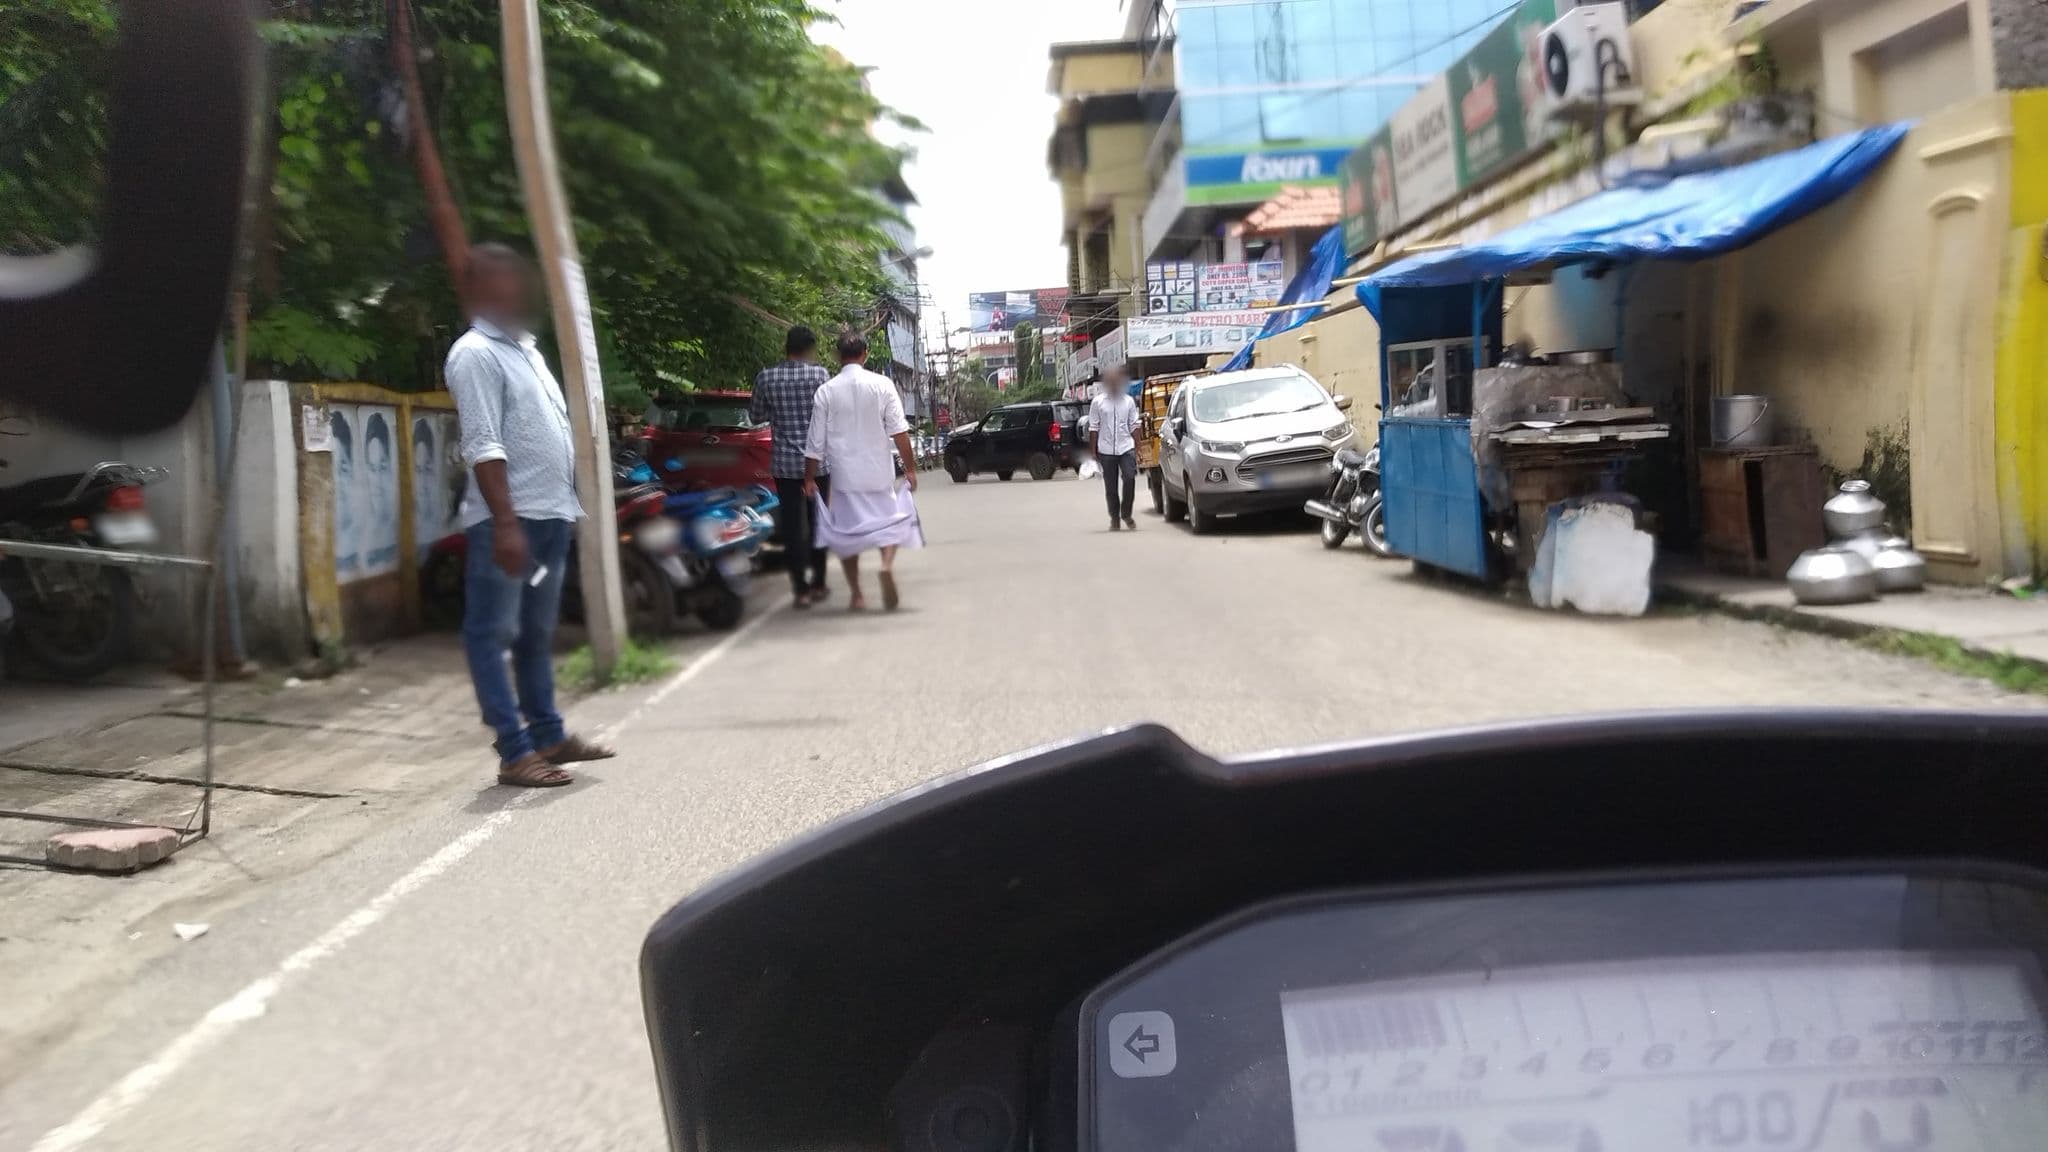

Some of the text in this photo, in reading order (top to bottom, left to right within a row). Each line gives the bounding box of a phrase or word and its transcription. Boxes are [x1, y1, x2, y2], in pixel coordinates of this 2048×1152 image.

[1190, 315, 1232, 327] METRO
[1393, 1059, 1429, 1088] 2
[1457, 1053, 1490, 1082] 3
[1518, 1051, 1549, 1078] 4
[1576, 1046, 1614, 1074] 5
[1642, 1042, 1677, 1069] 6
[1703, 1039, 1737, 1065] 7
[1763, 1036, 1799, 1065] 8
[1881, 1033, 1936, 1061] 10
